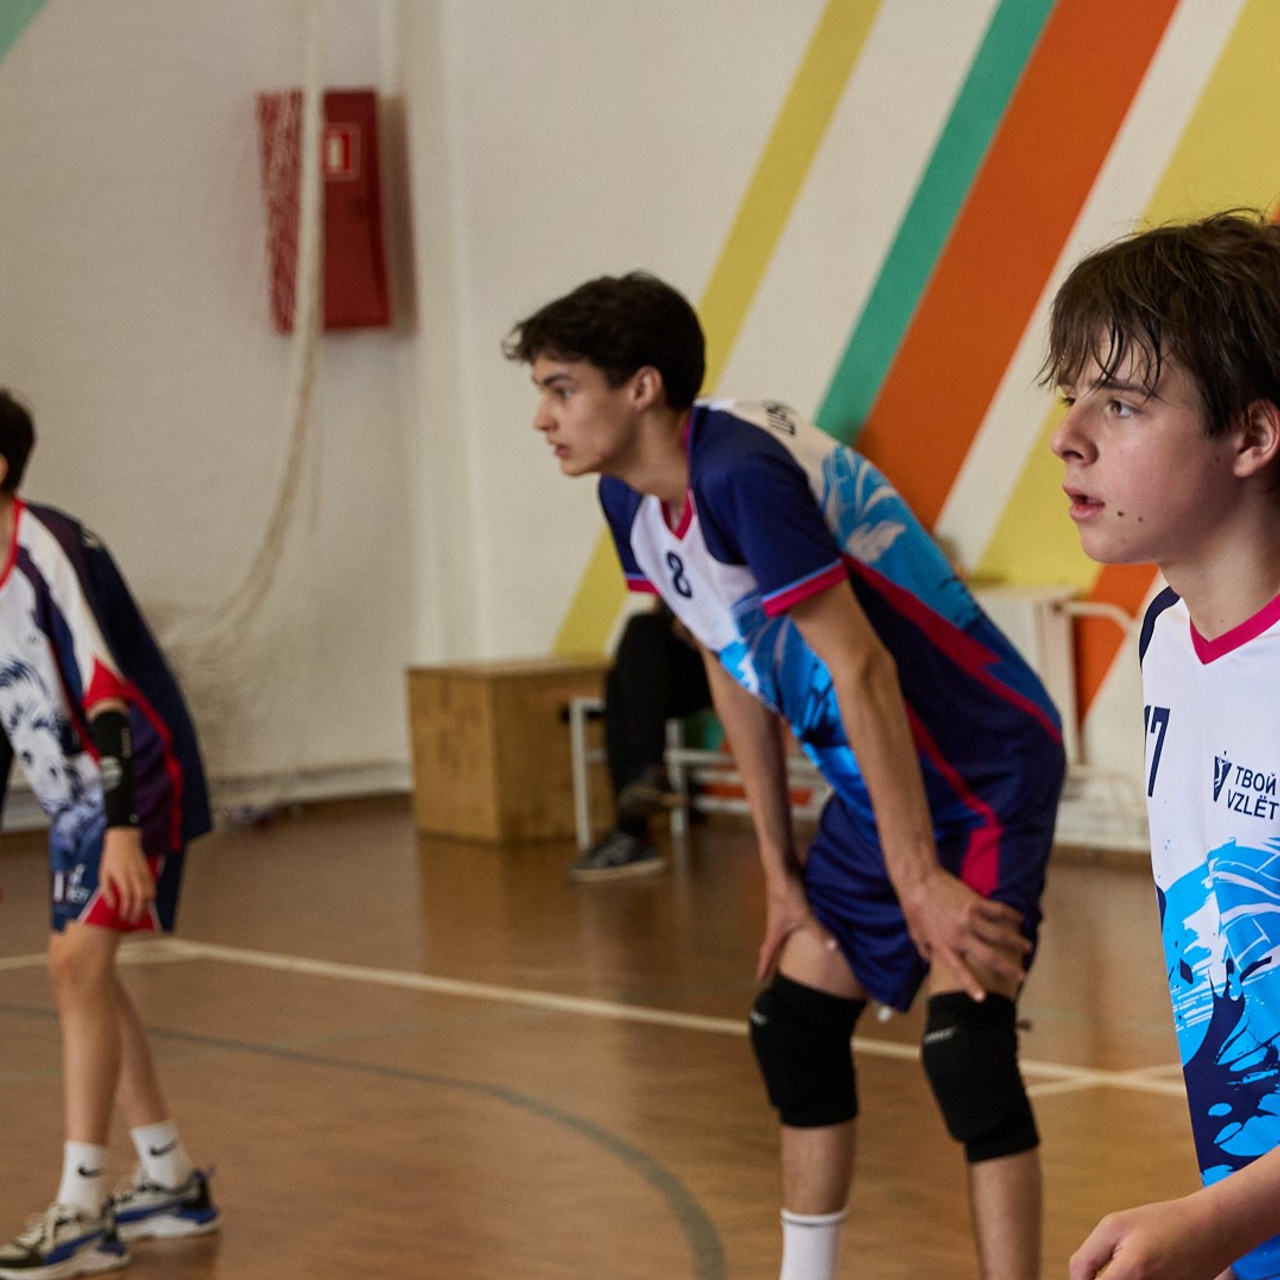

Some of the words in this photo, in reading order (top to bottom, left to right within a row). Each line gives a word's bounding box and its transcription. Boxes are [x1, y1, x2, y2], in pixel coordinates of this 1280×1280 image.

[667, 551, 692, 599] 8
[1235, 766, 1277, 796] ТВОЙ
[1228, 789, 1279, 820] VZLËT
